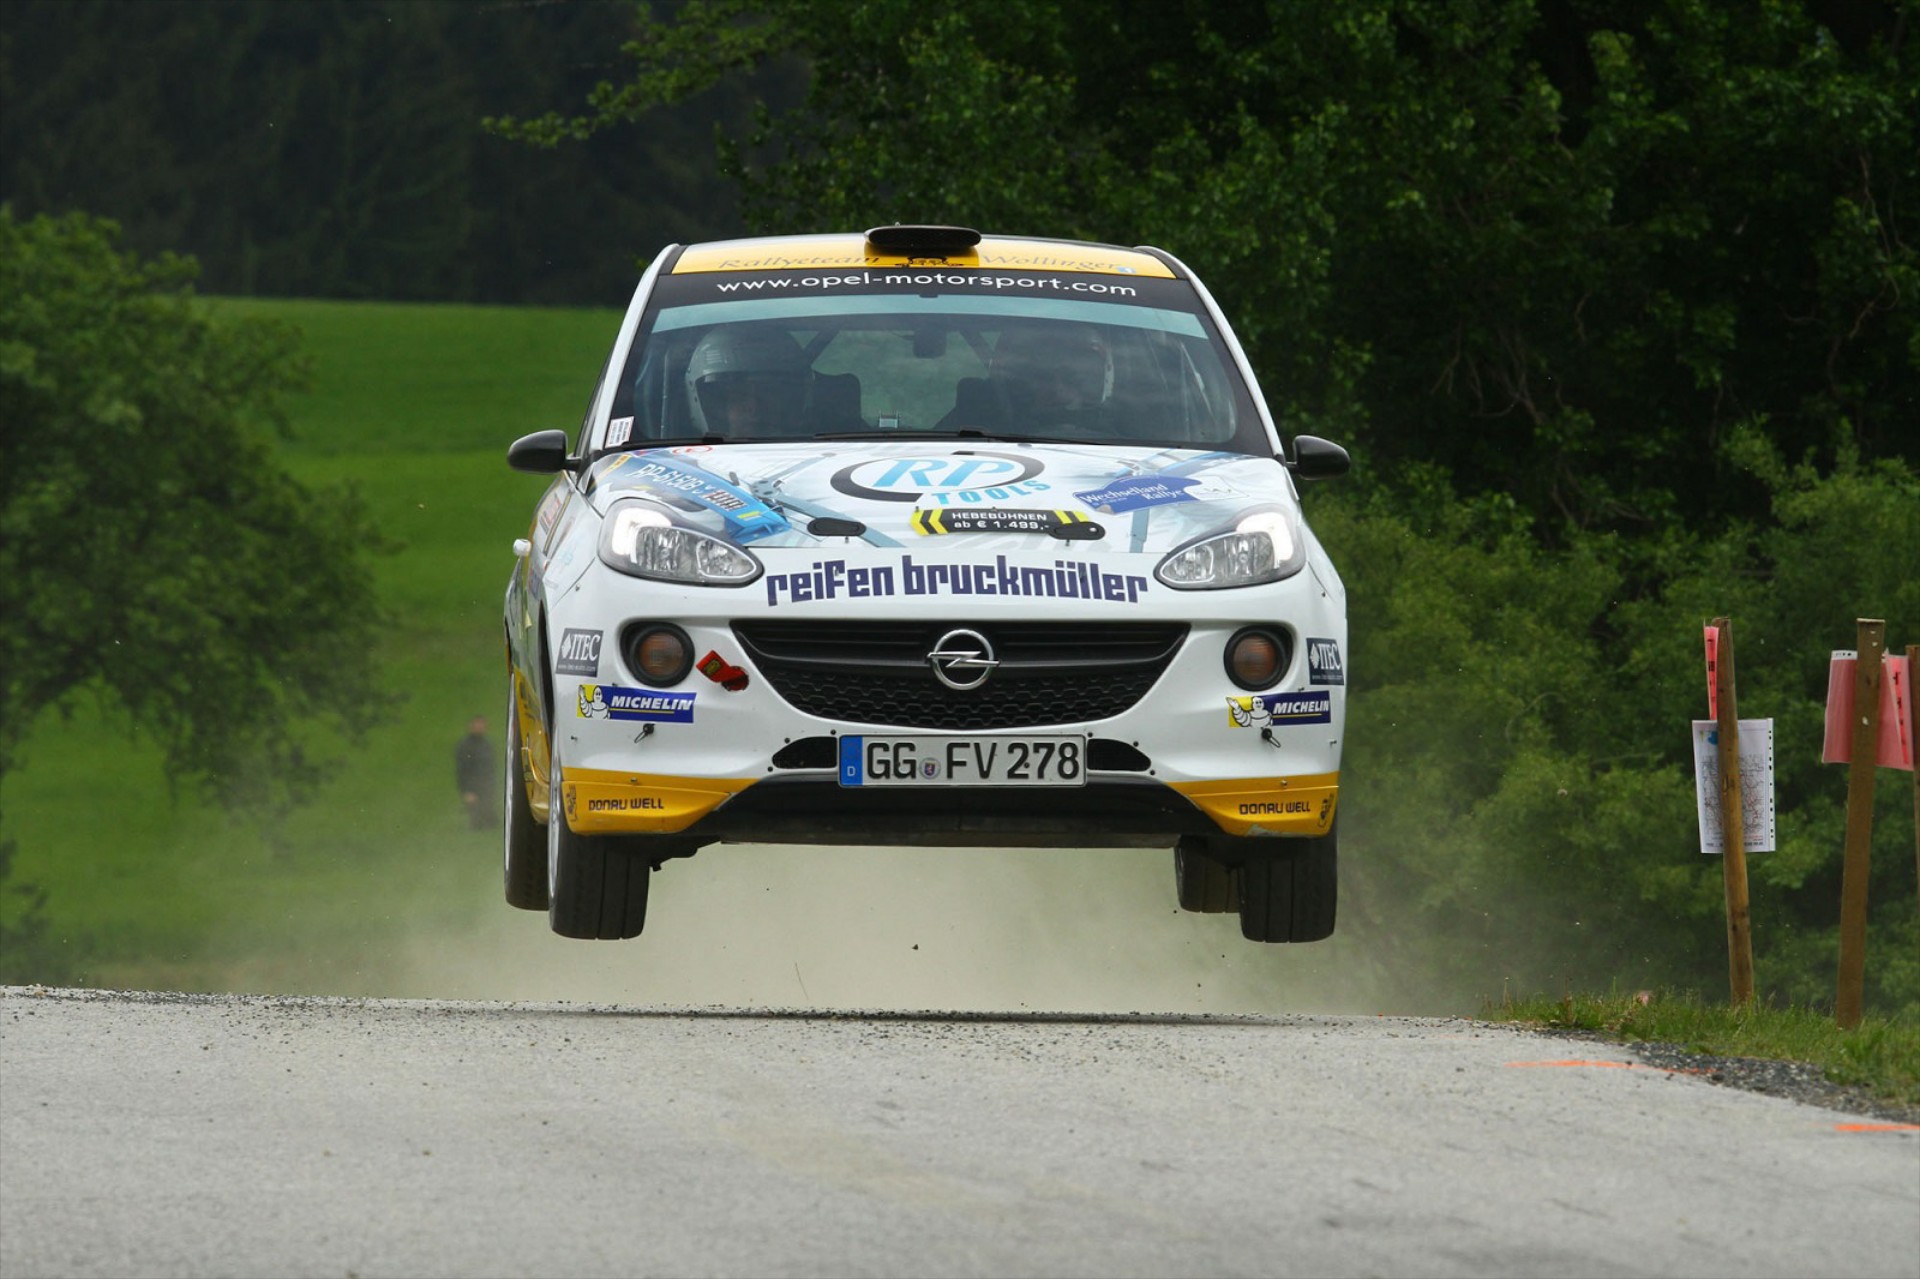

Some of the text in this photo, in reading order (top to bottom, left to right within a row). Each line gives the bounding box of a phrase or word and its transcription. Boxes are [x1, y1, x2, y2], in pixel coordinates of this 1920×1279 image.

[718, 255, 1116, 270] Rallyeteam Wollinger
[717, 272, 1137, 297] www.opel-motorsport.com
[873, 459, 1016, 488] RP
[932, 479, 1052, 505] TOOLS
[1080, 483, 1169, 503] Wechselland
[1141, 488, 1185, 501] Rallye
[952, 511, 1048, 521] HEBEBÜHNEN
[954, 520, 971, 529] ab
[766, 554, 1149, 607] reifen bruckmüller
[570, 633, 601, 661] ITEC
[1317, 643, 1342, 670] ITEC
[611, 695, 693, 711] MICHELIN
[1273, 701, 1330, 714] MICHELIN
[867, 742, 1080, 780] GG FV 278
[846, 765, 856, 777] D
[588, 798, 665, 811] DONAU WELL
[1239, 801, 1311, 815] DONAU WELL
